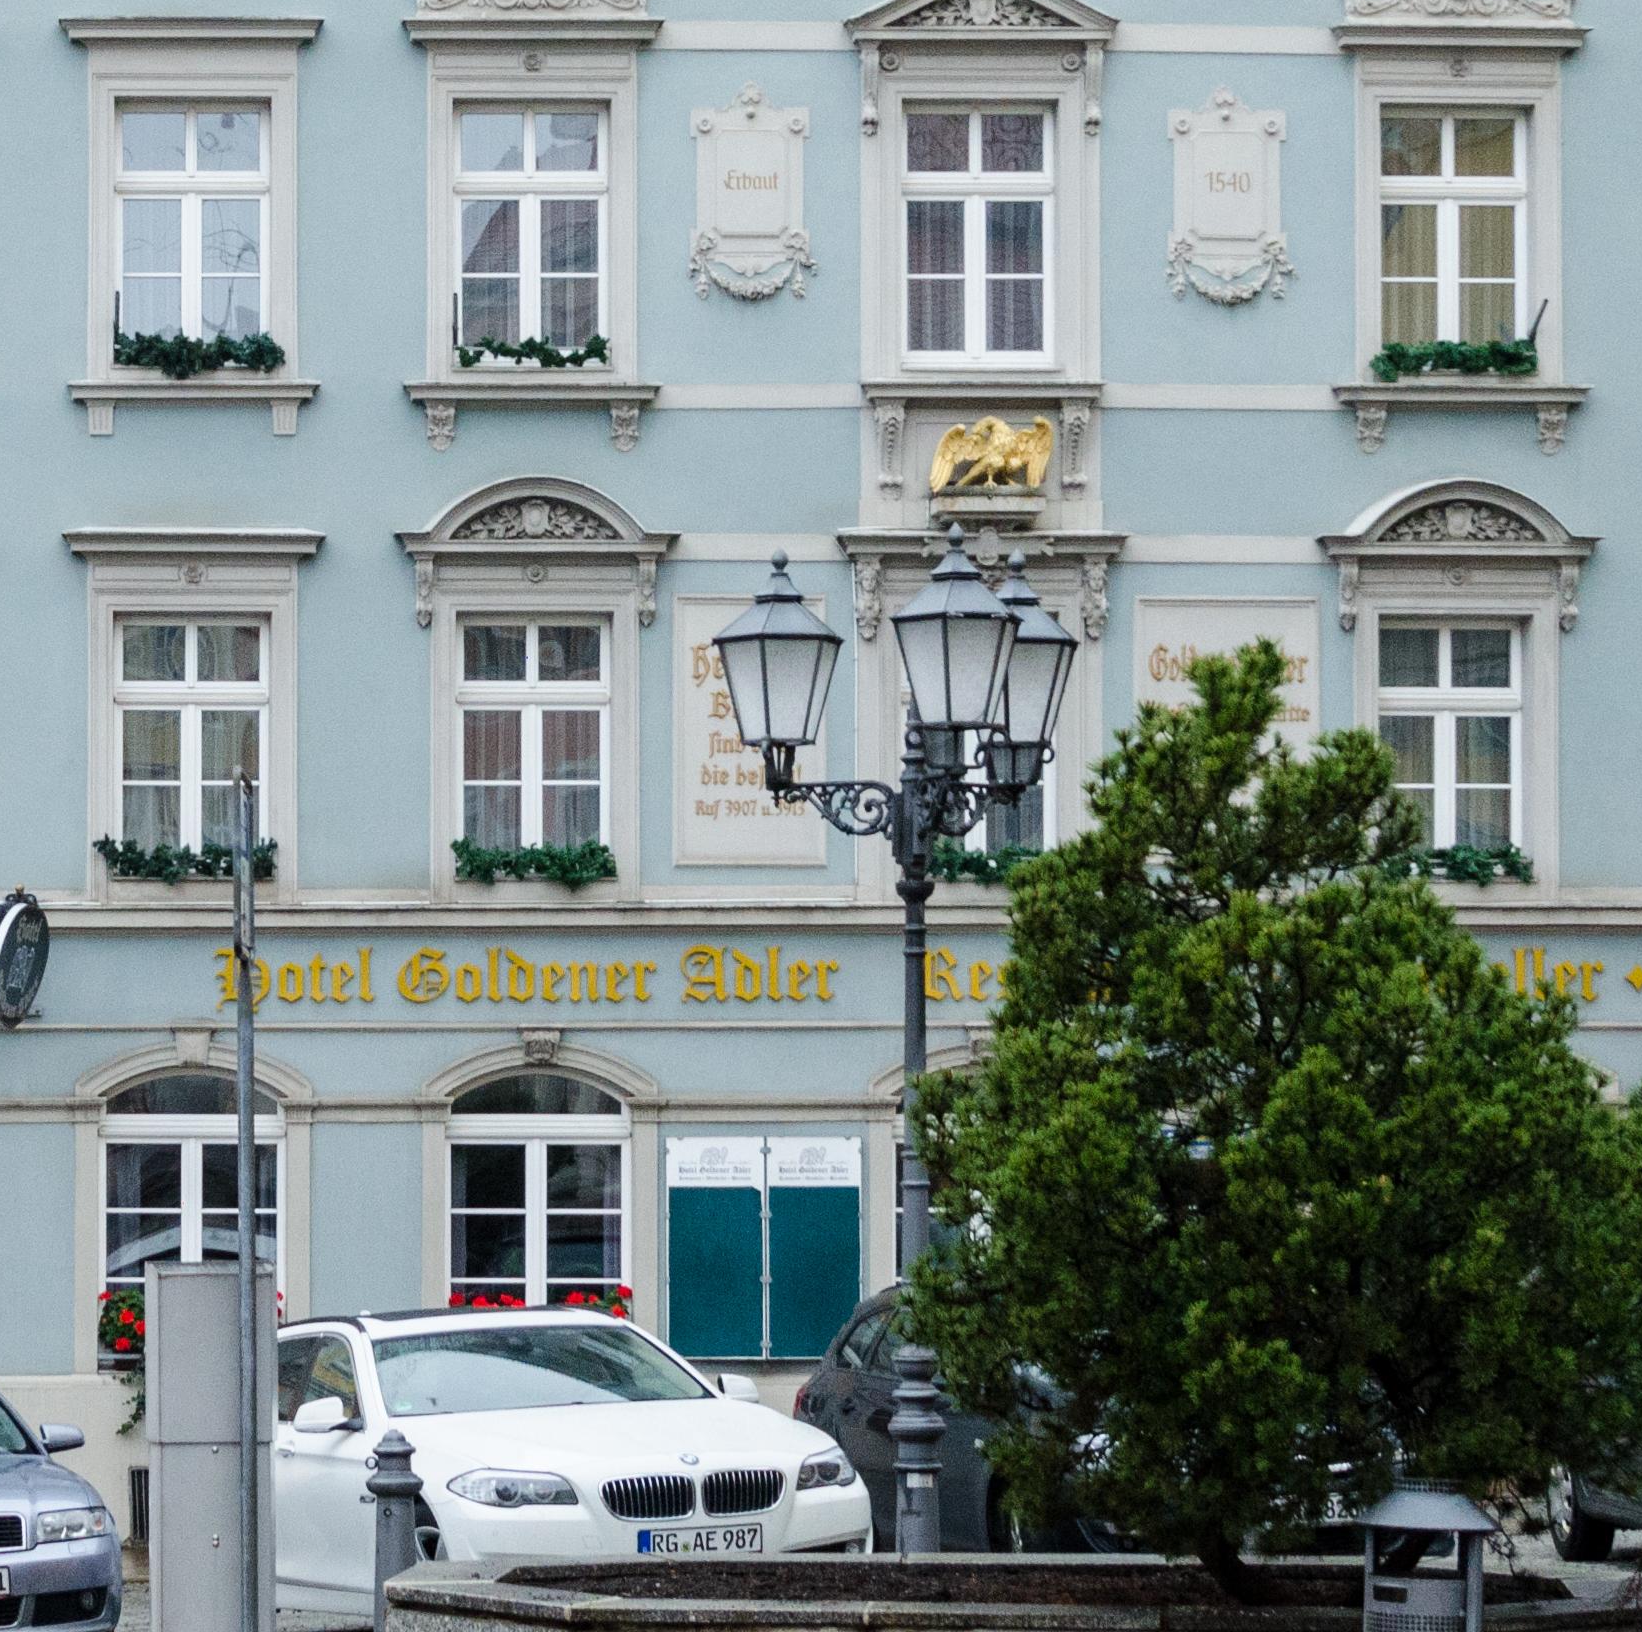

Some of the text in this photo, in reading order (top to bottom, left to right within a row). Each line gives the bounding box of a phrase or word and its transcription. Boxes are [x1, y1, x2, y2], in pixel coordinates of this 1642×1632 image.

[723, 169, 779, 191] Erbaut
[1204, 171, 1252, 193] 1540
[214, 943, 840, 1014] Hotel Goldener Adler
[652, 1528, 758, 1553] RG AE 987
